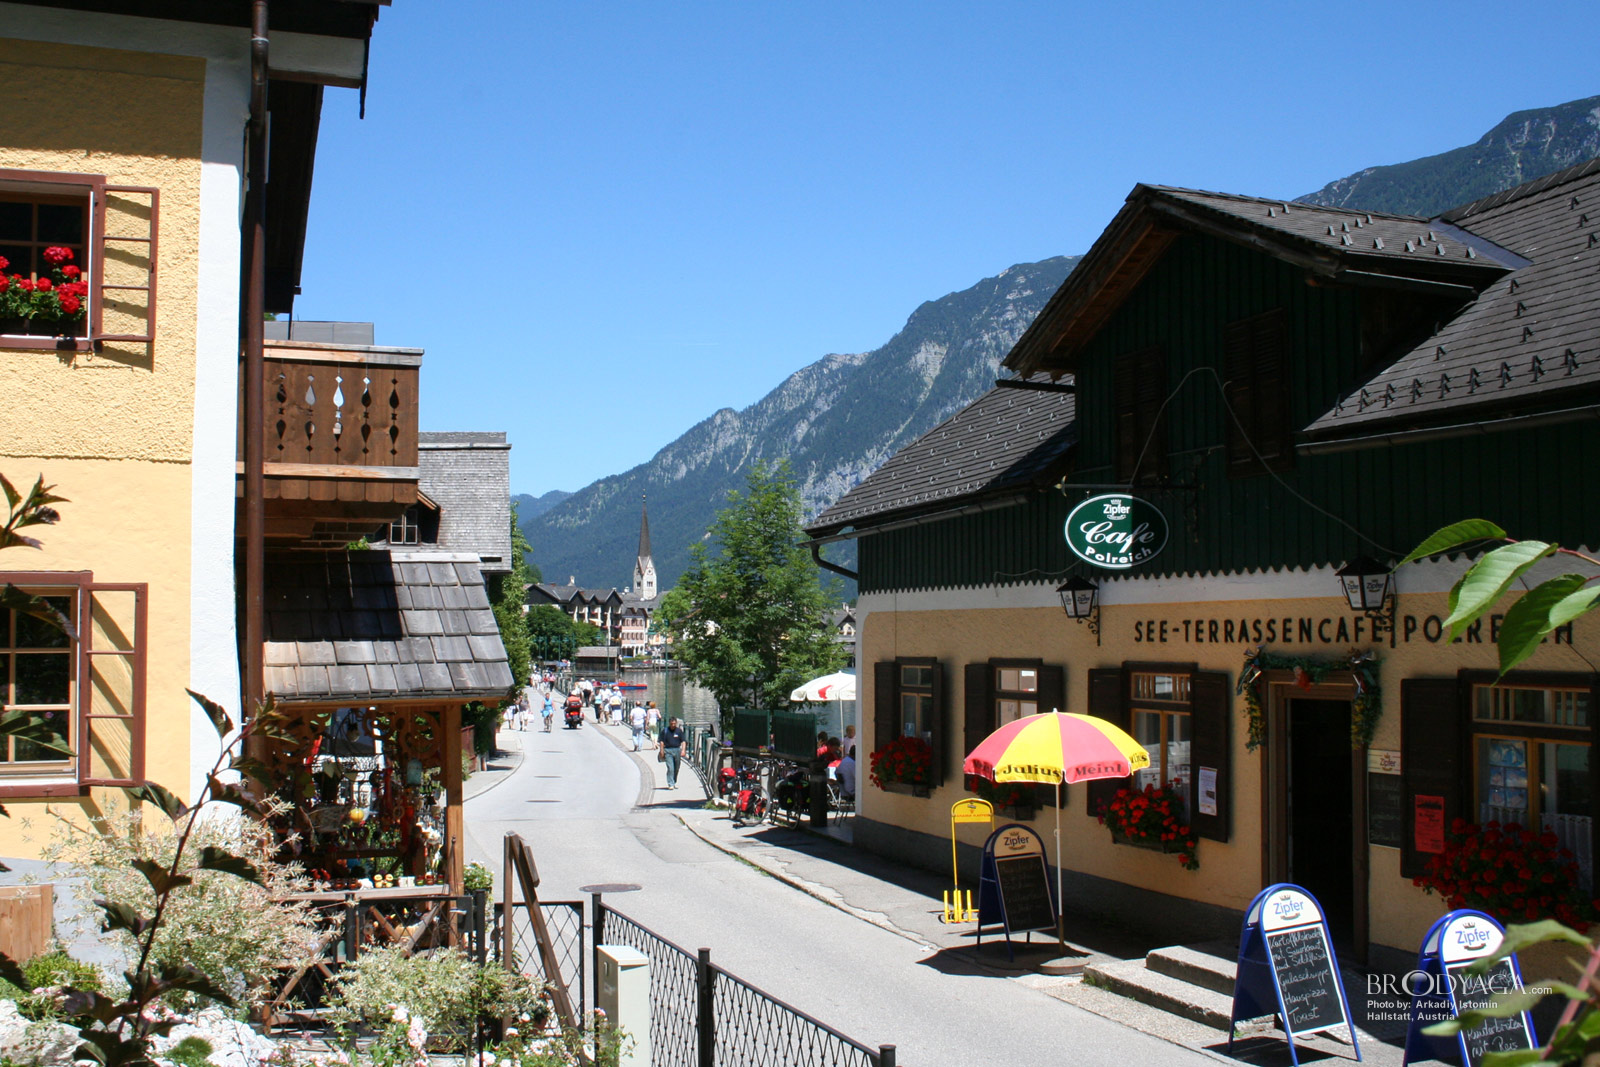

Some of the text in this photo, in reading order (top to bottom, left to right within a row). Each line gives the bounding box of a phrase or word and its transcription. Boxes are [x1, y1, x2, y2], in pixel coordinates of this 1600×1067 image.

[1103, 503, 1131, 516] Zipfer
[1080, 521, 1155, 554] Cafe
[1085, 546, 1152, 564] Polreich
[1134, 614, 1573, 645] SEE-TERRASSENCAFE POREH
[1003, 764, 1062, 778] Julius
[1075, 763, 1122, 776] Meinl
[1380, 757, 1397, 768] Zipfer
[1004, 836, 1029, 847] Zipfer
[1273, 900, 1304, 915] Zipfer
[1455, 928, 1491, 946] Zipfer
[1285, 988, 1328, 1006] Hauspizza
[1288, 1005, 1320, 1024] Toast
